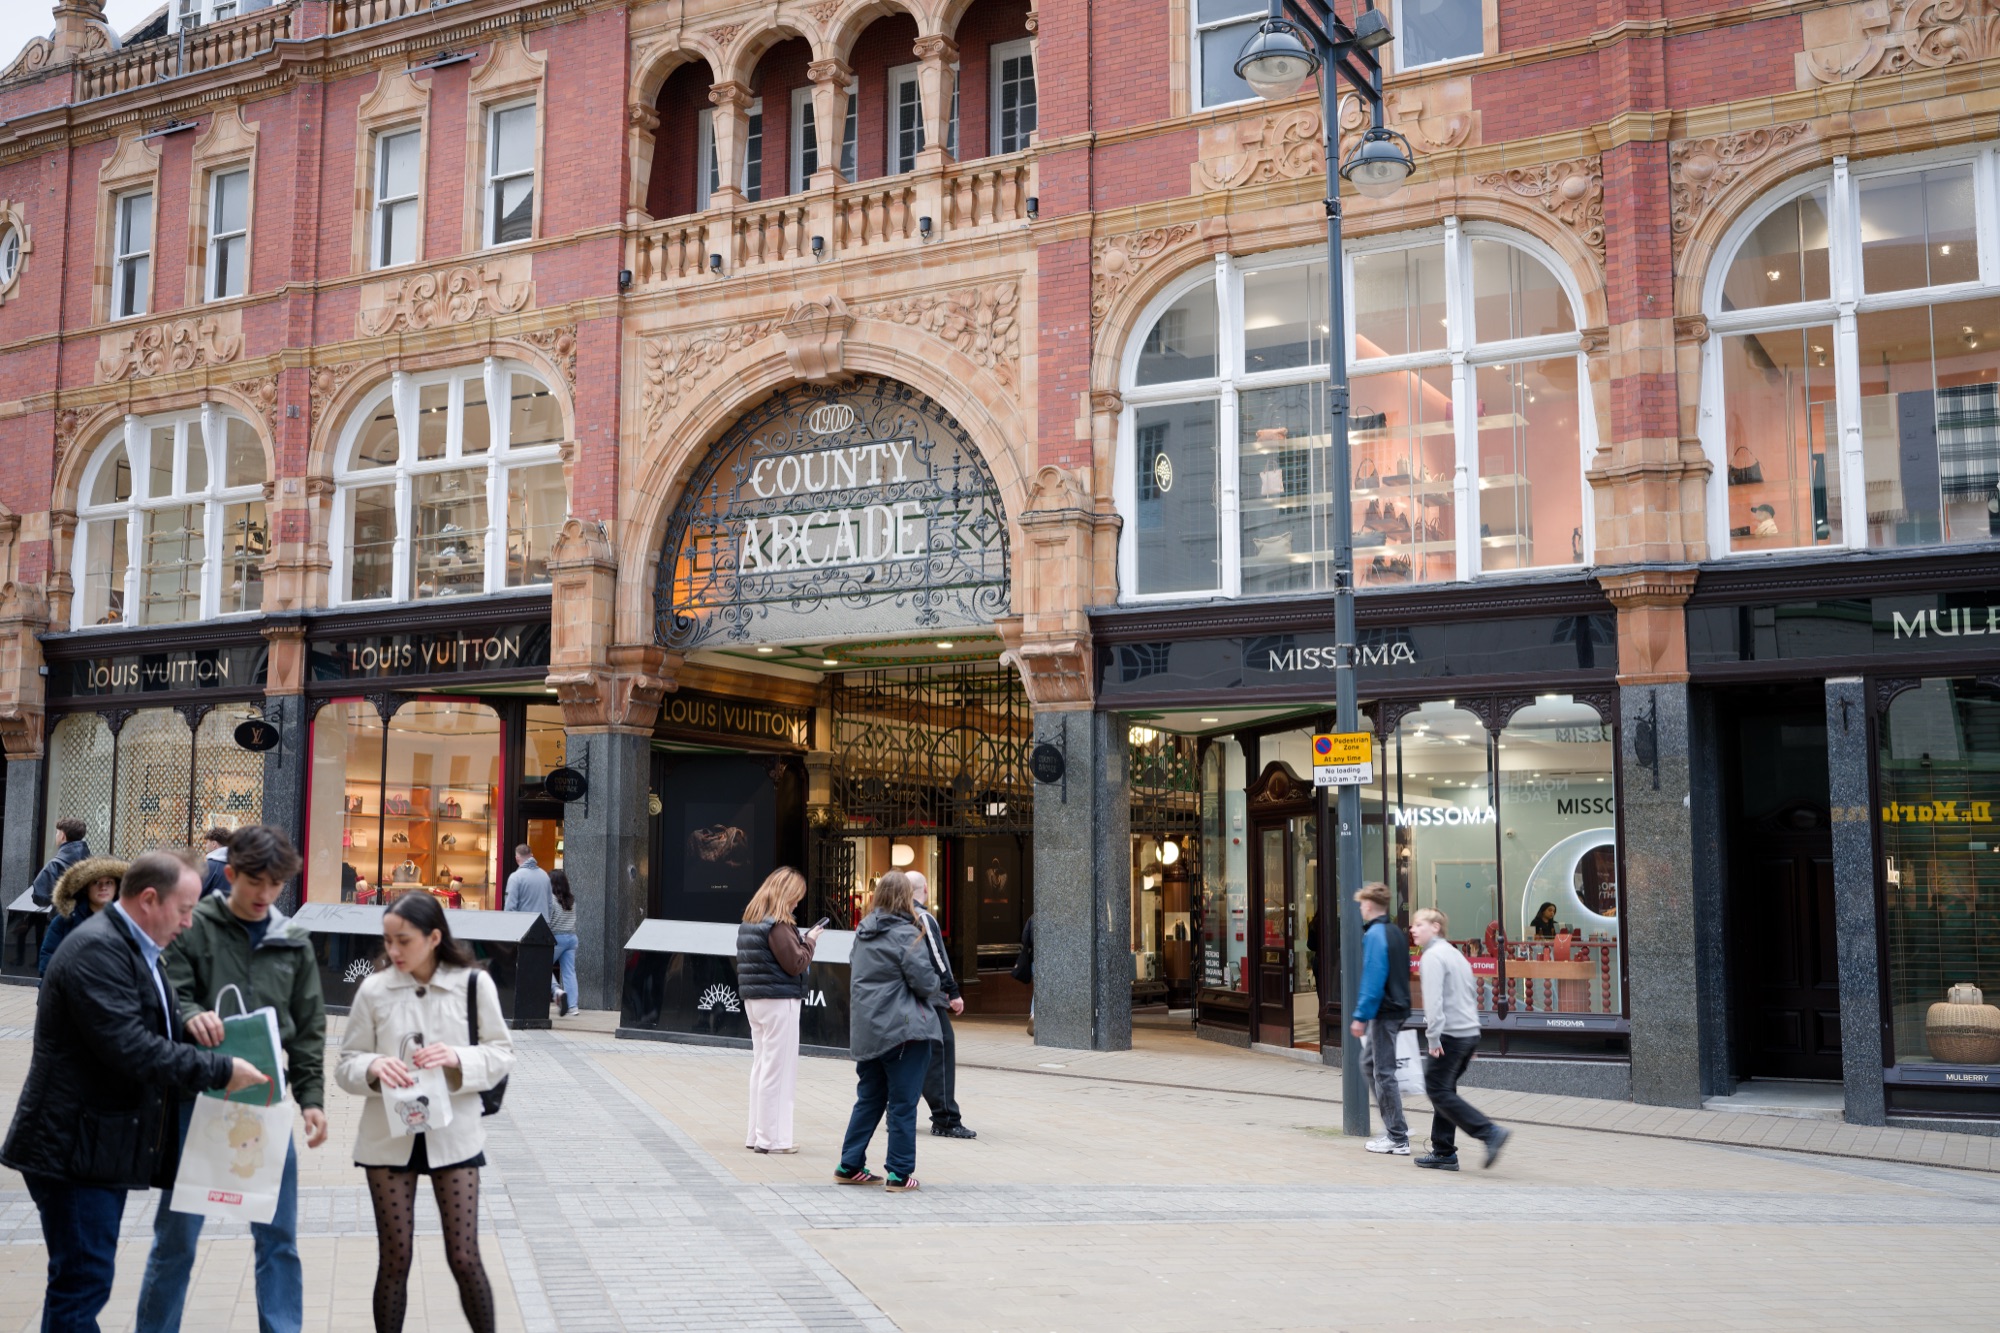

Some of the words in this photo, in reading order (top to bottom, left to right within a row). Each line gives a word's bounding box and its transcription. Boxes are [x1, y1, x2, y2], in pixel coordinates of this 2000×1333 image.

[815, 405, 849, 433] 1900
[749, 440, 912, 497] COUNTY
[739, 500, 924, 574] ARCADE
[352, 644, 412, 671] LOUIS
[421, 635, 520, 665] VUITTON
[1268, 642, 1416, 672] MISSMA
[87, 664, 139, 689] LOUIS
[145, 657, 229, 683] VUITTON
[663, 697, 717, 727] LOUIS
[723, 706, 799, 738] VUITTON
[1342, 822, 1348, 830] 9
[1394, 806, 1497, 826] MISSOMA
[1546, 1019, 1585, 1028] MISSOMA
[1946, 1073, 1989, 1082] MULBERRY
